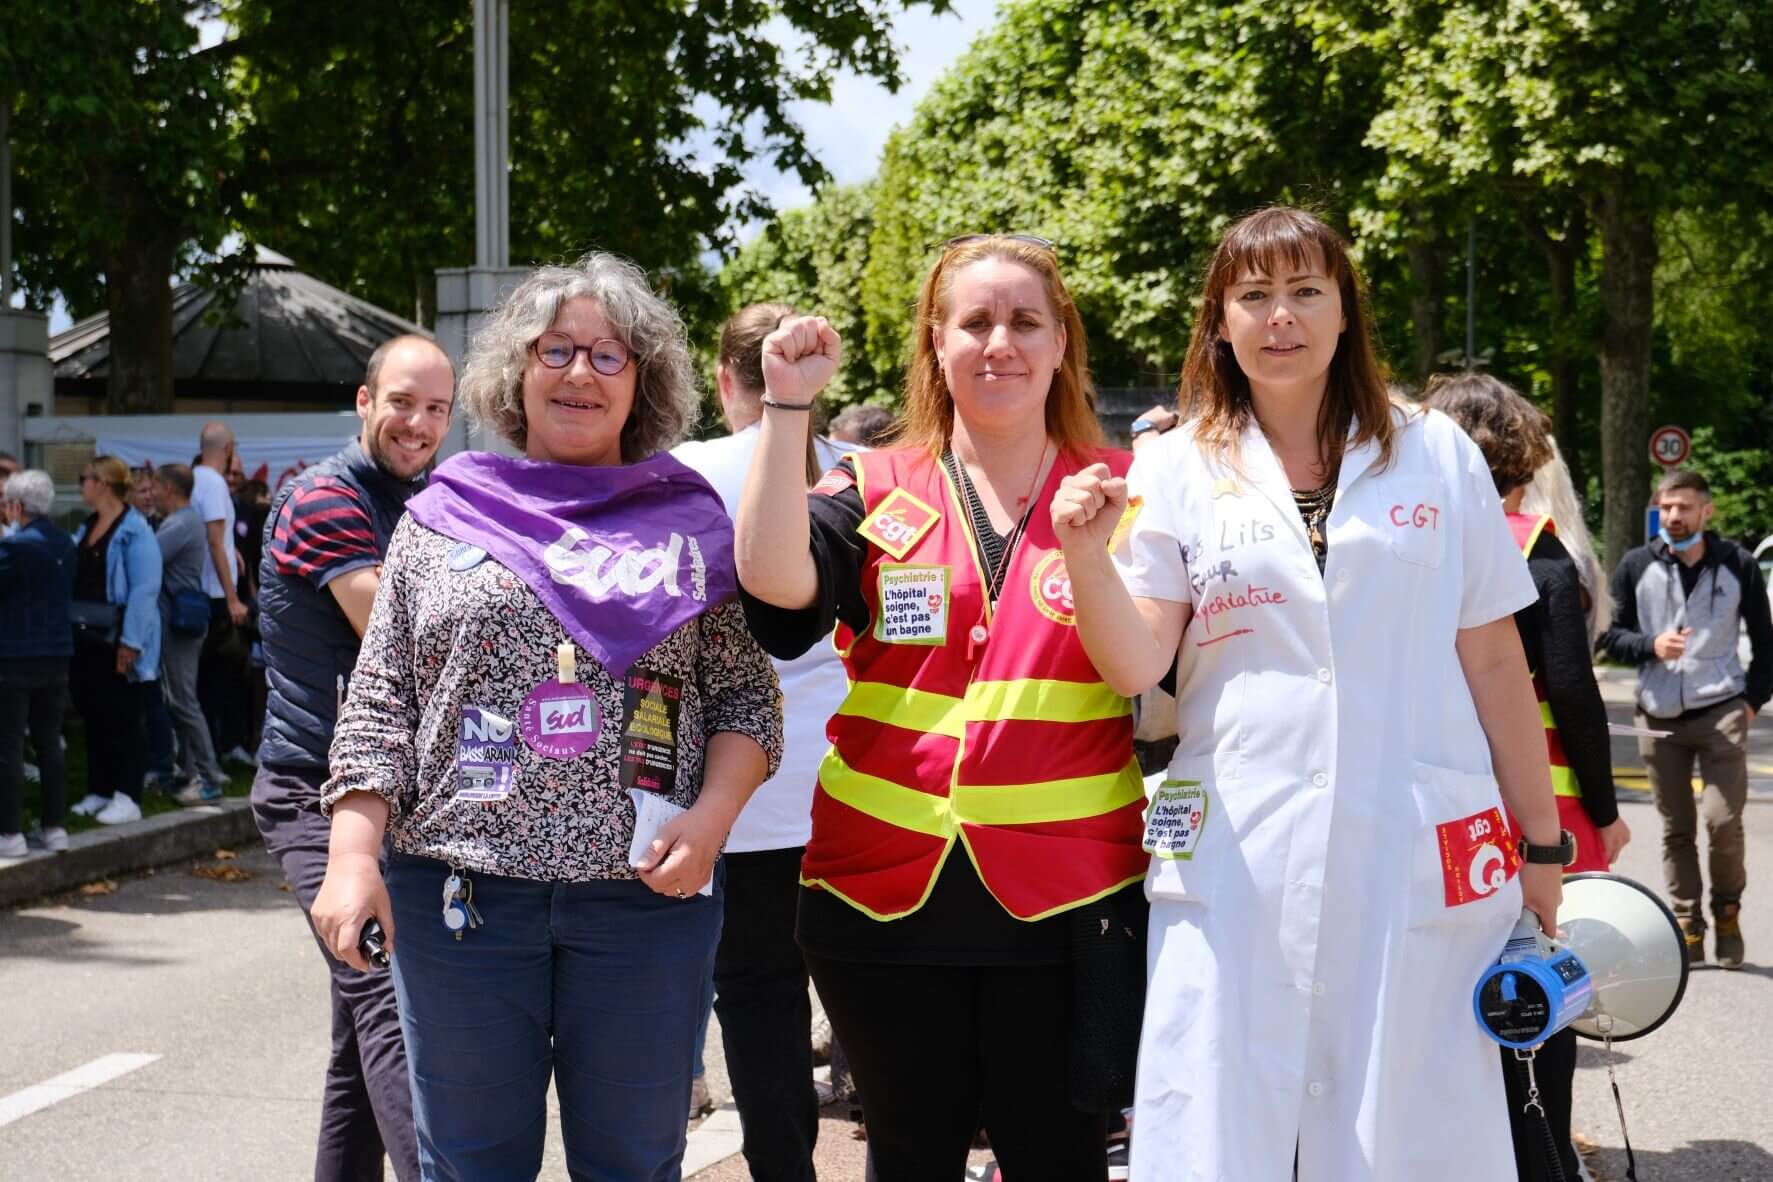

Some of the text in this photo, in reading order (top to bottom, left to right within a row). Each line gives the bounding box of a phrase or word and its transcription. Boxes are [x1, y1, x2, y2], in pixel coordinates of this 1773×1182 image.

[1658, 438, 1681, 456] 30
[1390, 503, 1440, 531] CGT
[874, 513, 918, 545] cgt
[1219, 519, 1275, 552] Lits
[884, 571, 937, 585] Psychiatrie
[885, 587, 927, 601] L'hôpital
[885, 601, 920, 613] soigne,
[885, 613, 931, 624] c'est pas
[886, 624, 932, 636] un bagne
[628, 676, 680, 700] URGENCES
[640, 698, 668, 714] SOCIALE
[633, 709, 671, 728] SALARIALE
[463, 714, 513, 743] NO
[530, 734, 577, 755] Sociaux
[1158, 787, 1201, 802] Psychiatrie
[1155, 804, 1192, 817] L'hôpital
[1151, 817, 1184, 829] soigne,
[1468, 818, 1492, 842] cgt
[1147, 827, 1190, 840] c'est pas
[1160, 839, 1186, 851] bagne
